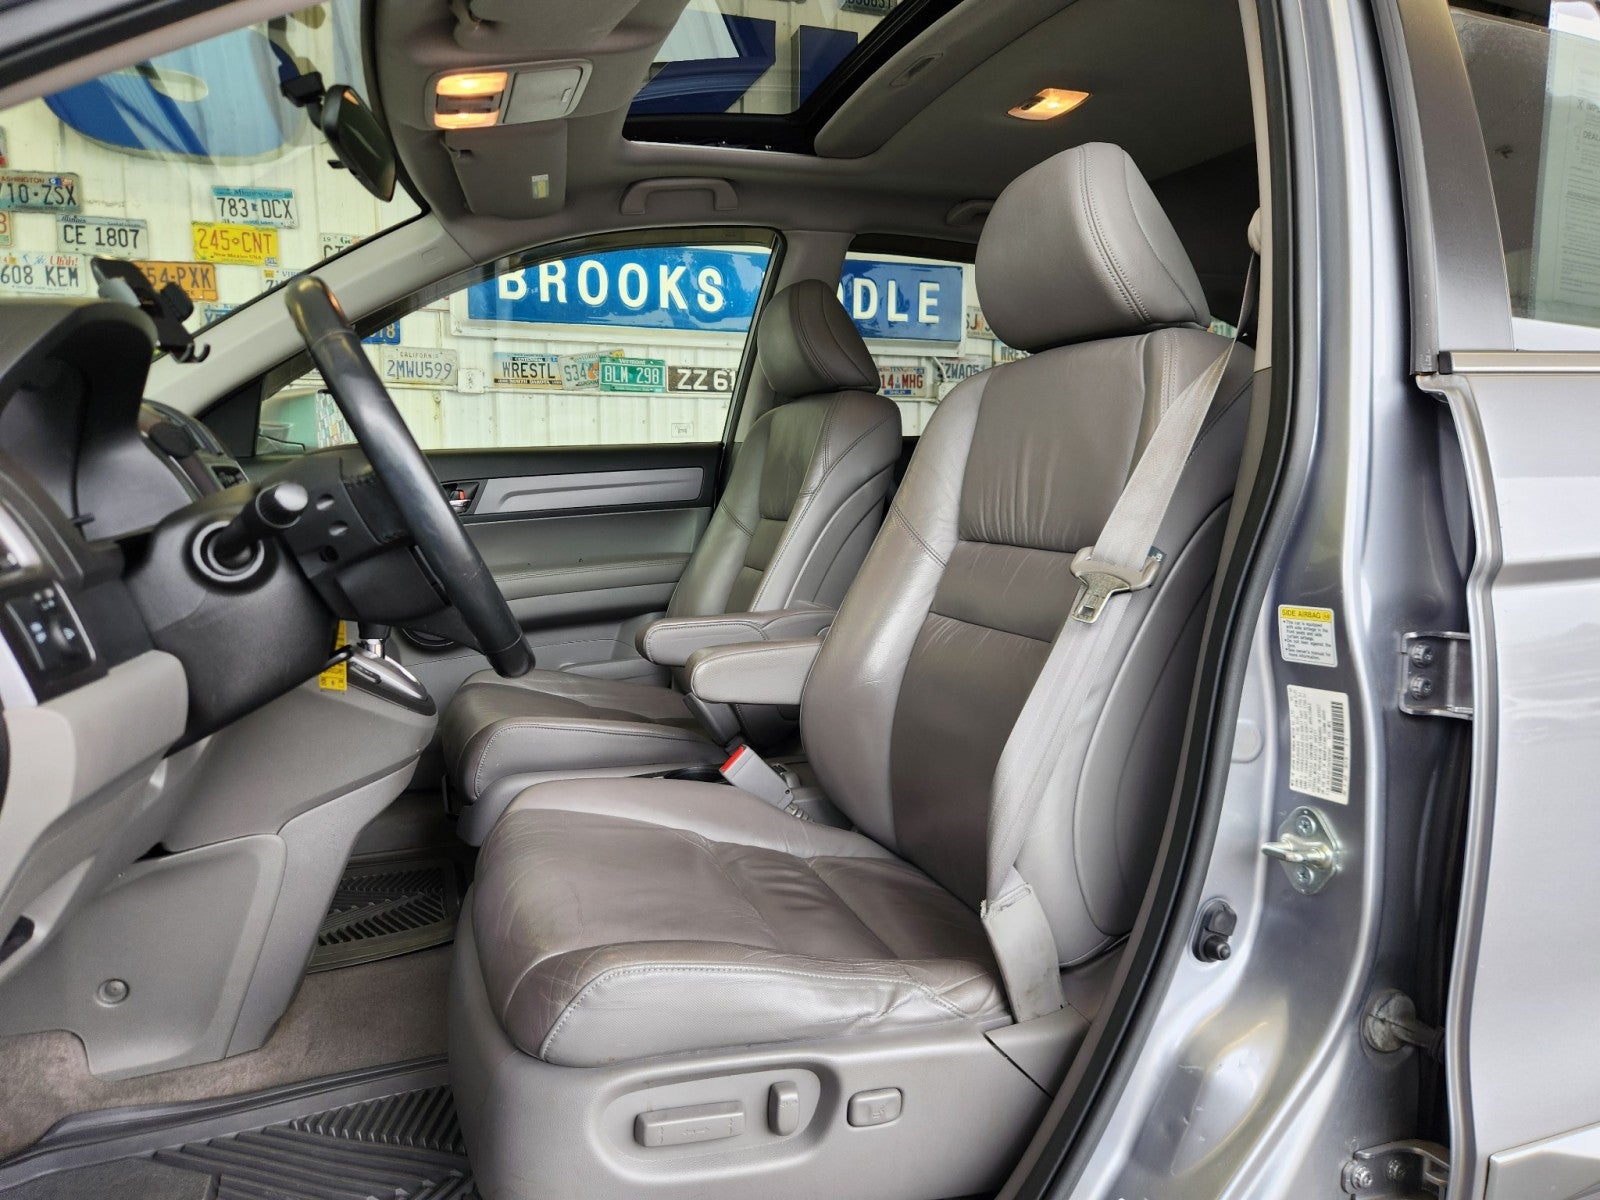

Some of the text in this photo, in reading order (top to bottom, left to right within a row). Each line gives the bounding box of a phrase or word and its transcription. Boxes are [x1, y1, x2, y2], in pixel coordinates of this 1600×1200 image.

[0, 183, 76, 205] 10-ZSX
[217, 198, 293, 219] 783 DCX
[63, 224, 139, 249] CE 1807
[197, 229, 271, 254] 245 CNT
[1, 265, 79, 287] 608 KEM
[140, 267, 212, 289] 54-PXK
[499, 259, 940, 324] BROOKS DLE
[387, 360, 452, 380] 2MWU599
[502, 361, 556, 379] WRESTL
[636, 367, 660, 385] 298
[677, 368, 708, 390] ZZ
[901, 374, 924, 389] MHG
